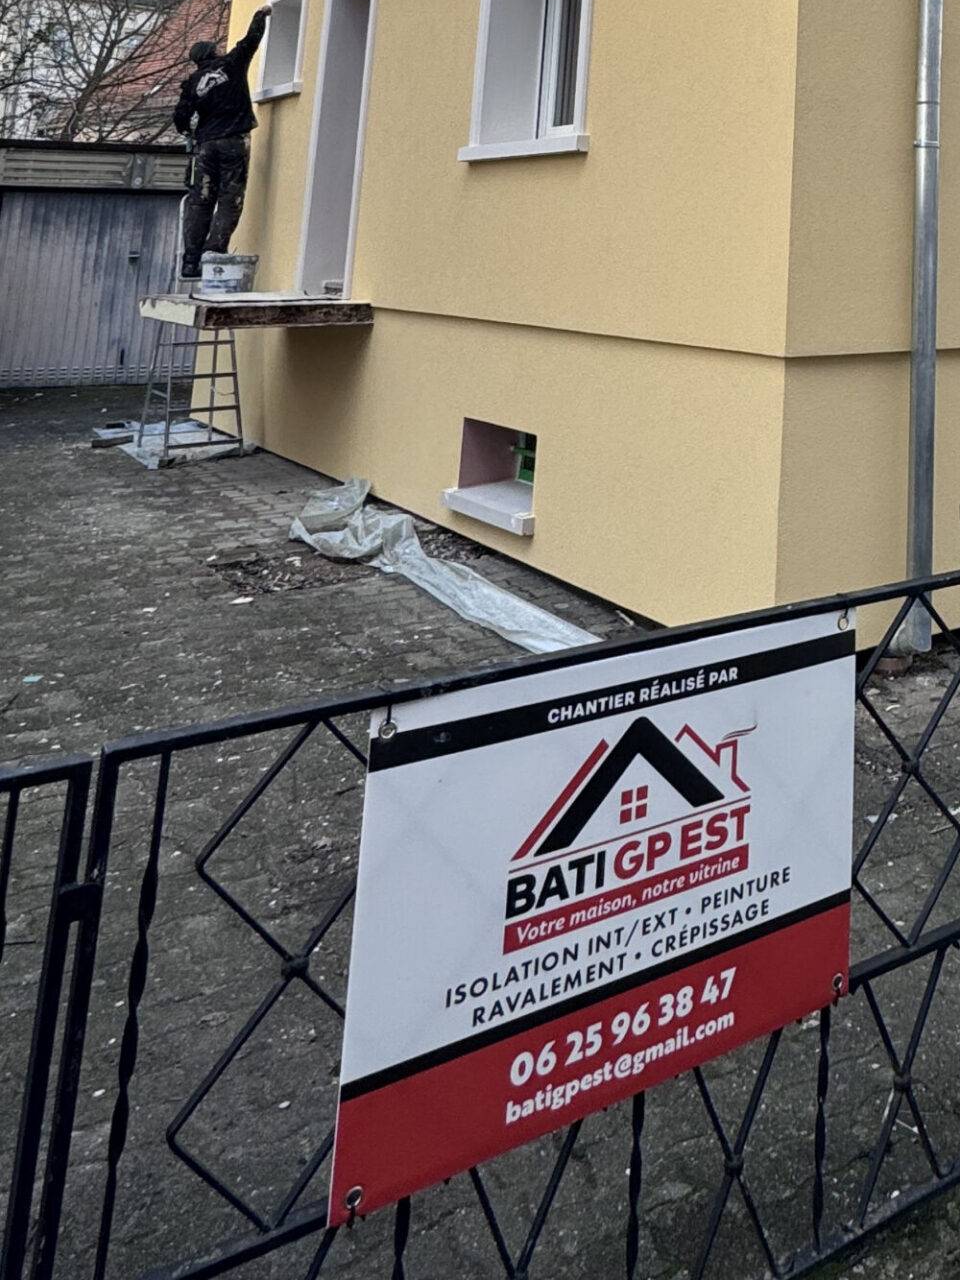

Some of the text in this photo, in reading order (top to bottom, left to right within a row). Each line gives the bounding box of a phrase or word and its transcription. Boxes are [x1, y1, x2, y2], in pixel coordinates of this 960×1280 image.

[547, 667, 738, 723] CHANTIER RÉALISÉ PAR
[445, 866, 791, 1008] ISOLATION INT/EXT PEINTURE
[505, 851, 606, 919] BATI
[516, 856, 740, 944] Votre maison, notre vitrine
[472, 899, 770, 1028] RAVALEMENT CRÉPISSAGE
[506, 1011, 735, 1126] batigpest@gmail.com
[509, 966, 737, 1086] 06 25 96 38 47
